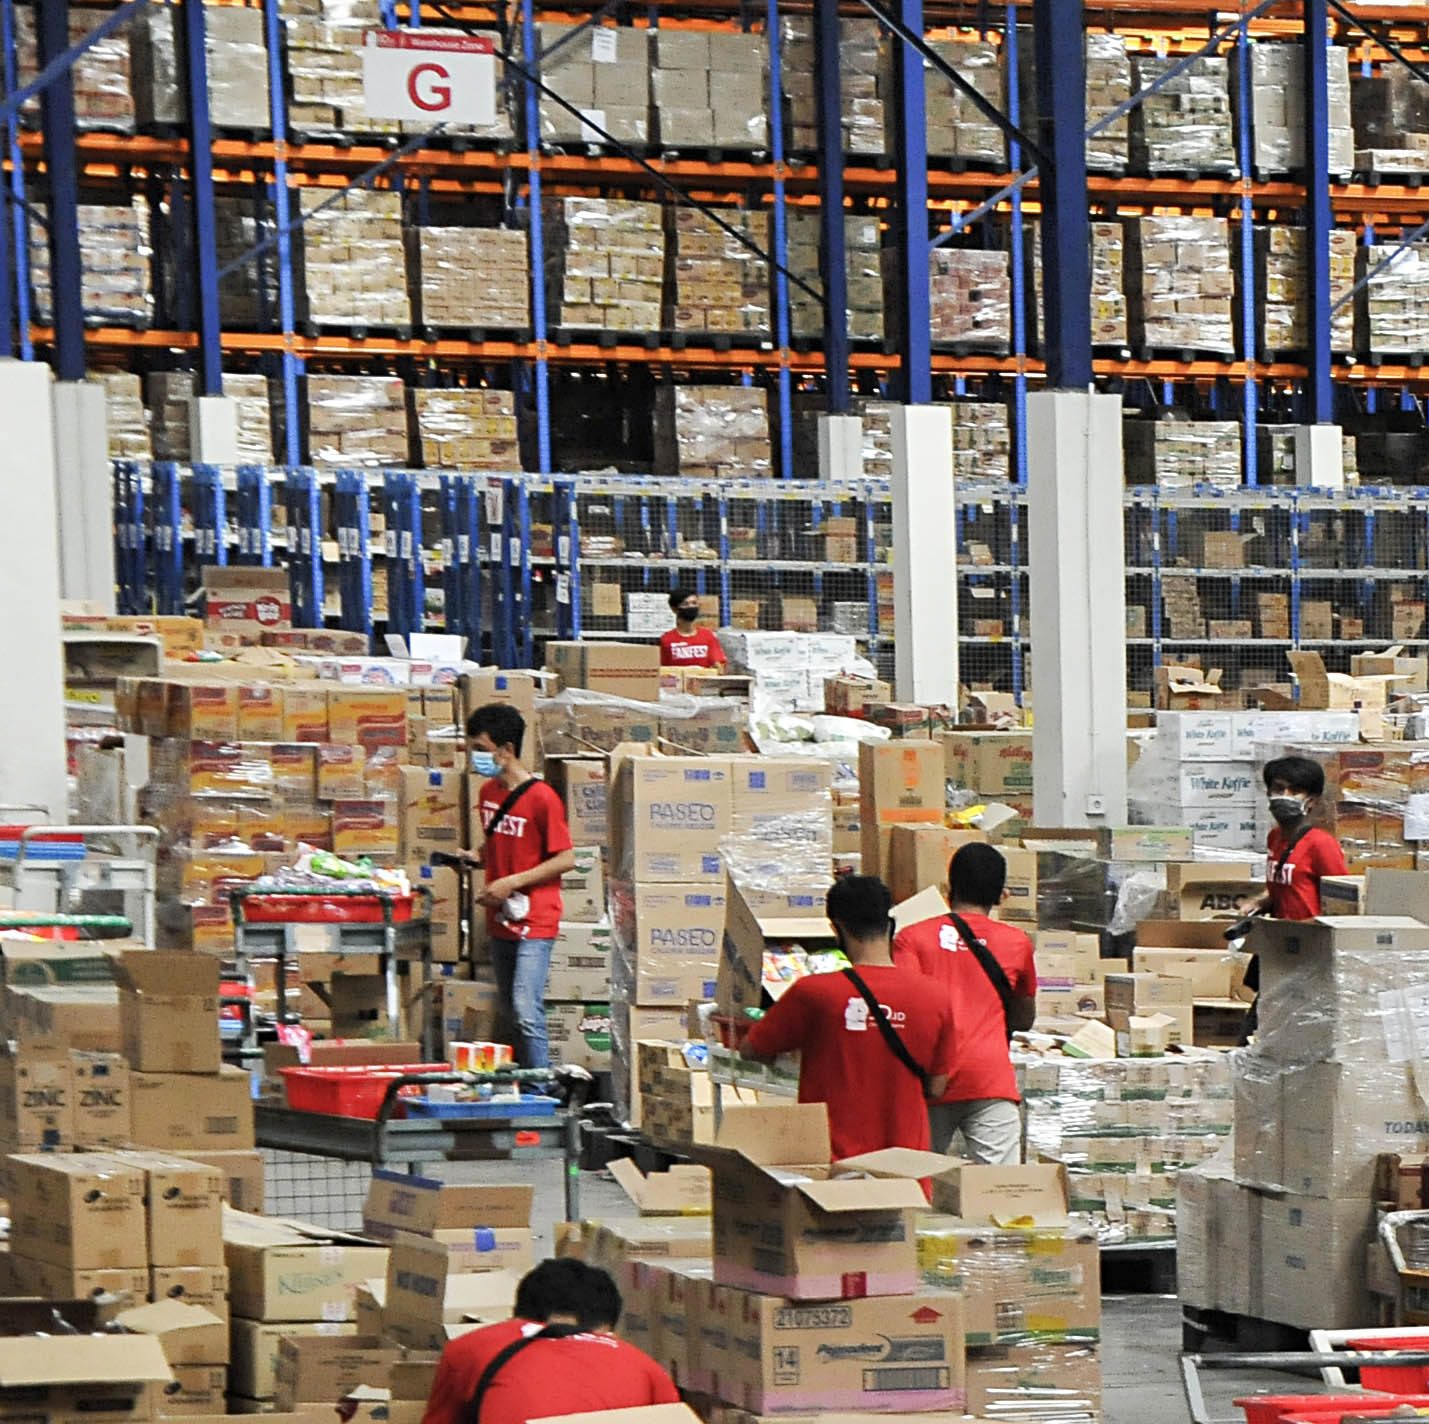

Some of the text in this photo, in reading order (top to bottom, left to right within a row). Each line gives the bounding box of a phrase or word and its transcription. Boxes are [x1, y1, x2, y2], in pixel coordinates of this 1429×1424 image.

[407, 64, 451, 112] G
[1191, 777, 1251, 792] White Koffie
[650, 803, 715, 822] PASEO
[650, 928, 716, 948] PASEO
[776, 1350, 796, 1370] 14
